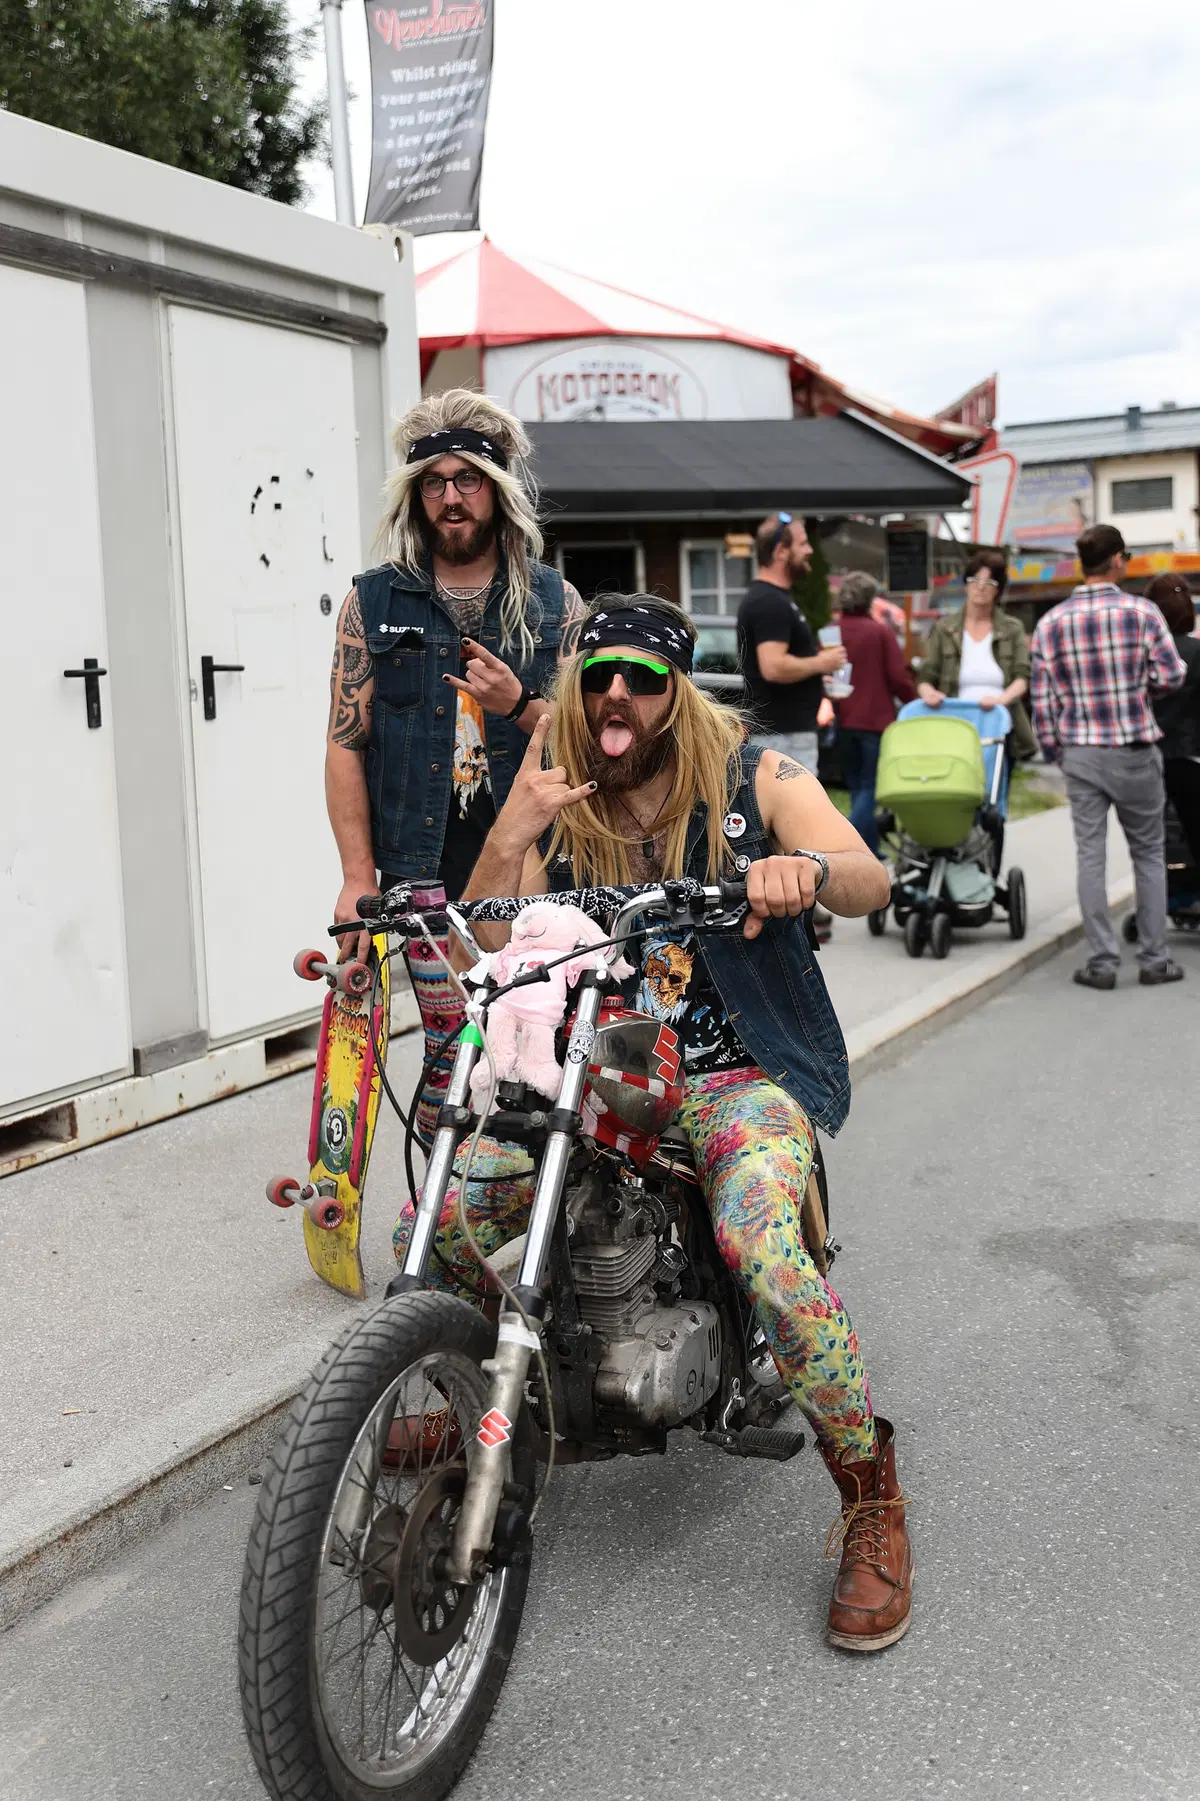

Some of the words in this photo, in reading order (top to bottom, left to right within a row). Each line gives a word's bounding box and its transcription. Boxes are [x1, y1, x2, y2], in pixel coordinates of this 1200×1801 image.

[391, 65, 436, 84] Whilst
[438, 59, 478, 78] riding
[380, 93, 414, 109] your
[389, 114, 415, 131] you
[417, 108, 455, 124] forget
[398, 133, 422, 148] few
[396, 155, 418, 168] the
[536, 372, 684, 421] MOTODROM
[340, 994, 363, 1014] JEFF
